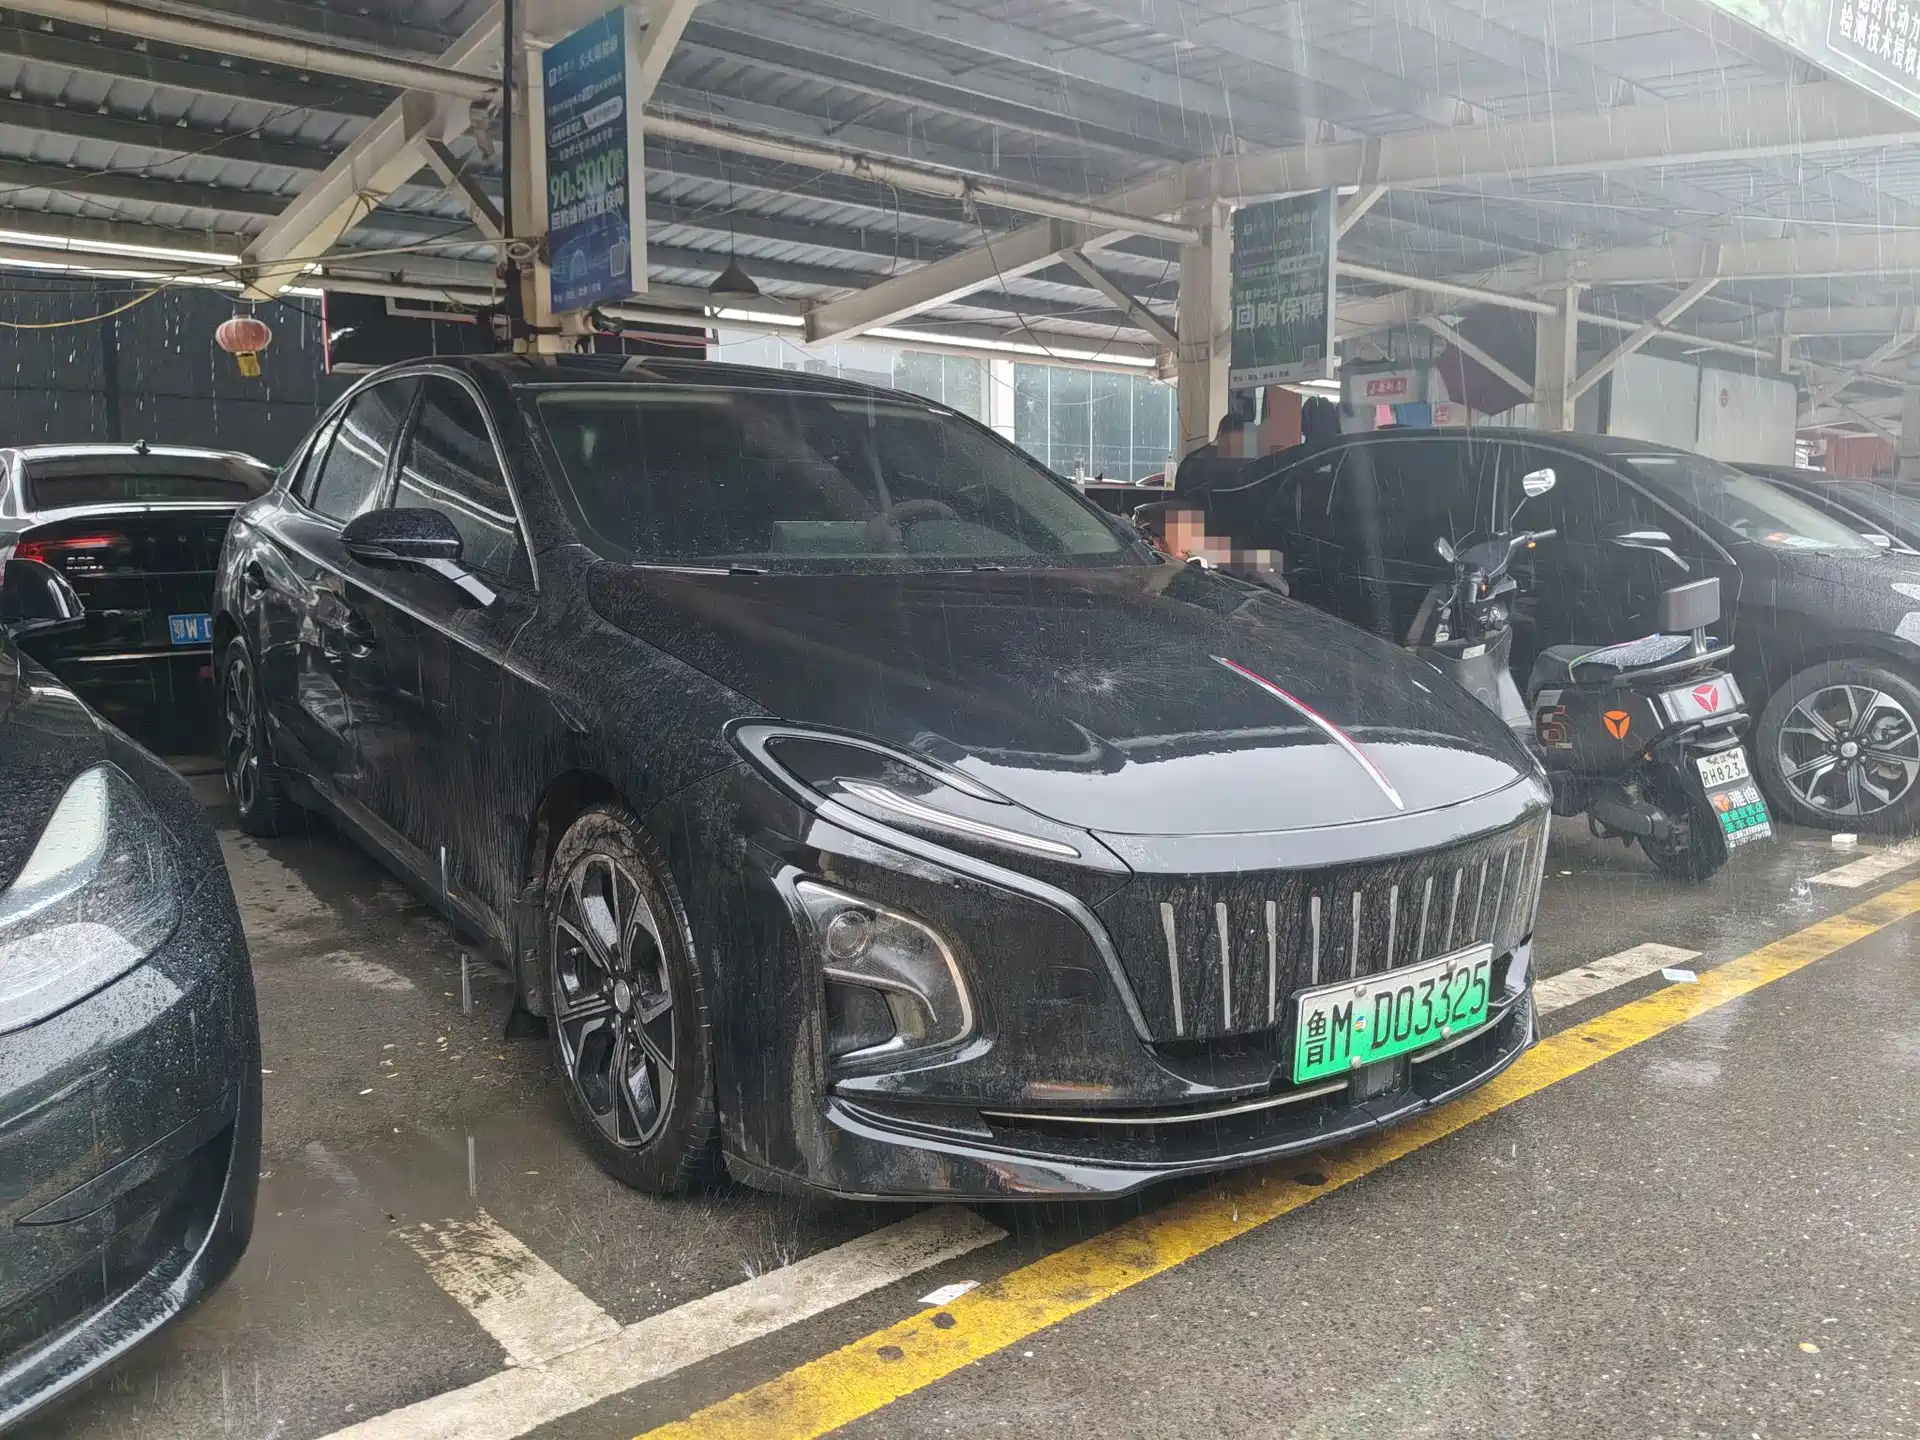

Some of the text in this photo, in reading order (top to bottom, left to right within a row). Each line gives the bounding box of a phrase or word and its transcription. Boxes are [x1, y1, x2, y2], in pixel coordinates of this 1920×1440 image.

[1236, 293, 1324, 332] 回购保障
[1702, 762, 1741, 786] RH823
[1727, 786, 1760, 808] 雅迪
